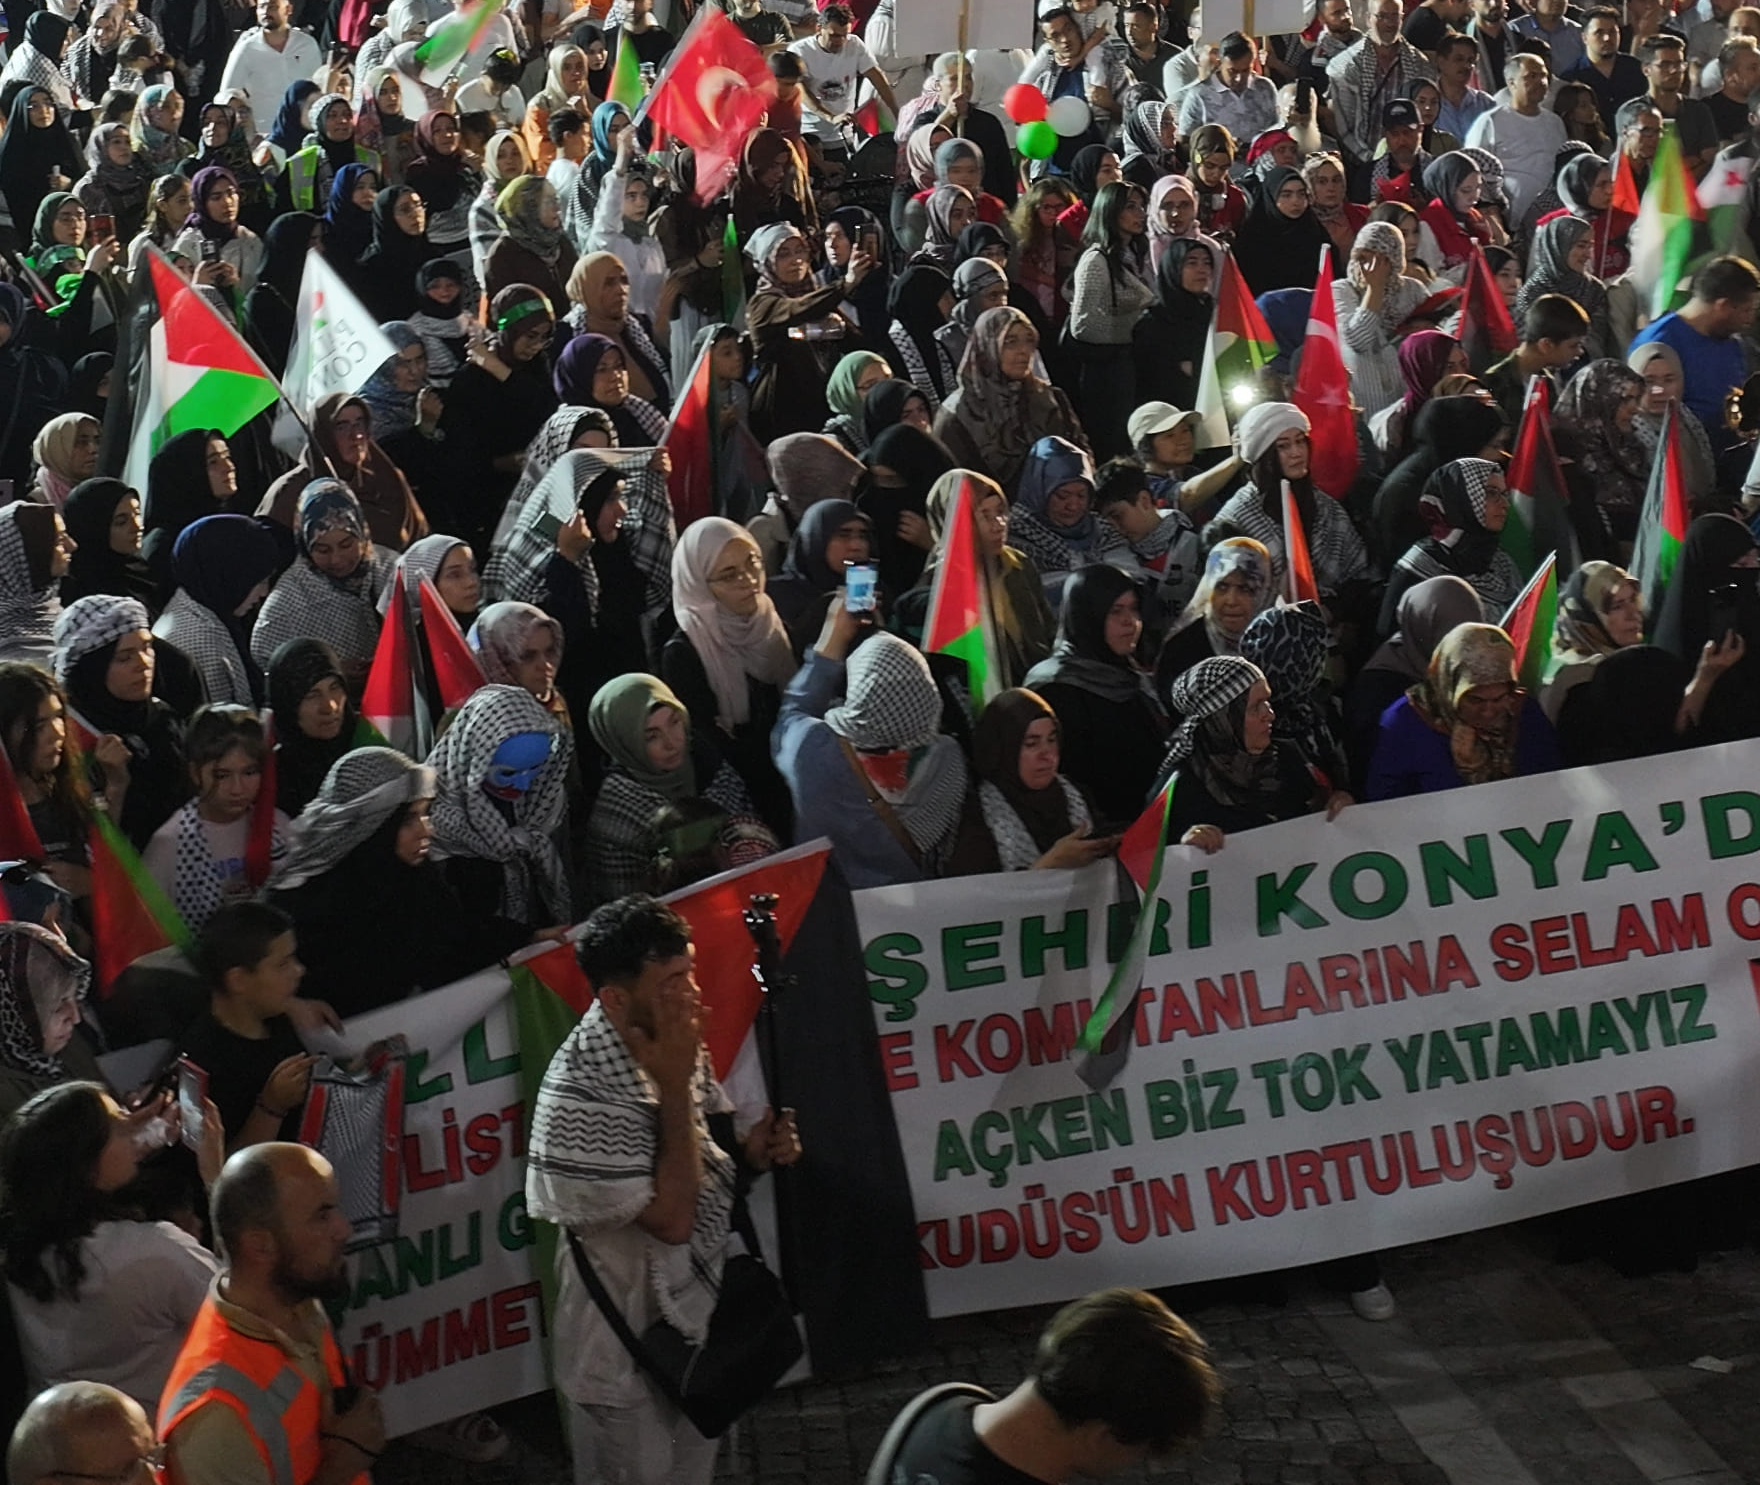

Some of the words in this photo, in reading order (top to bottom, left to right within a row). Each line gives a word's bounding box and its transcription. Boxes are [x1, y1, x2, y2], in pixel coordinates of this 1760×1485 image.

[864, 870, 1212, 1023] ŞEHRİ
[1493, 891, 1711, 985] SELAM
[933, 1088, 1133, 1188] AÇKEN
[1145, 1058, 1245, 1141] BİZ
[1252, 1042, 1381, 1118] TOK
[1385, 982, 1717, 1096] YATAMAYIZ
[916, 1166, 1196, 1272] KUDÜS'ÜN
[1206, 1084, 1695, 1226] KURTULUŞUDUR.
